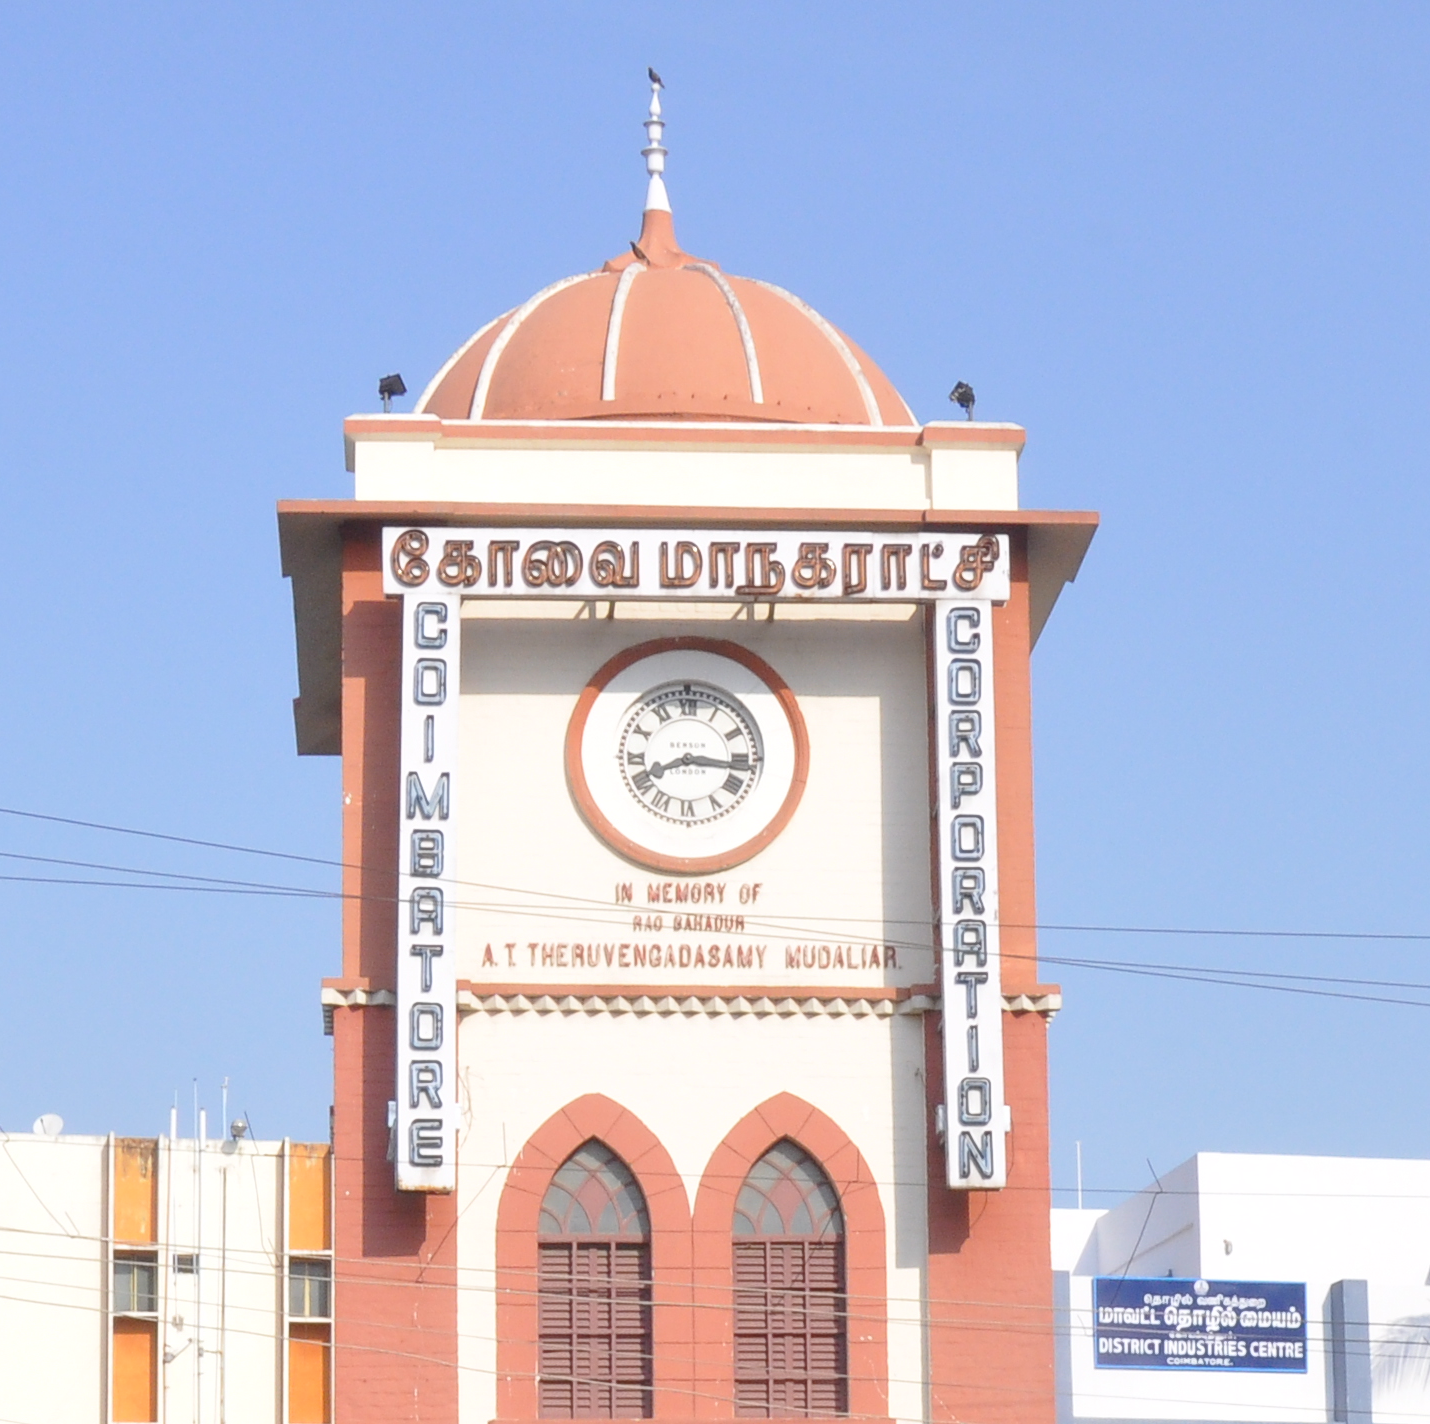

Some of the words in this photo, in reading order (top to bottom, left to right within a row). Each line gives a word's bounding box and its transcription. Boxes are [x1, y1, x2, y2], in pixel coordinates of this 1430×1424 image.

[669, 741, 707, 749] BENSON
[406, 601, 451, 1167] COIMBATORE
[616, 883, 633, 904] IN
[647, 883, 726, 904] MEMORY
[739, 883, 763, 904] OF
[946, 605, 995, 1180] CORPORATION
[528, 943, 767, 969] THERUVENGADASAMY
[1099, 1337, 1161, 1355] DISTRICT
[1164, 1339, 1246, 1356] INDUSTRIES
[1250, 1341, 1303, 1358] CENTRE
